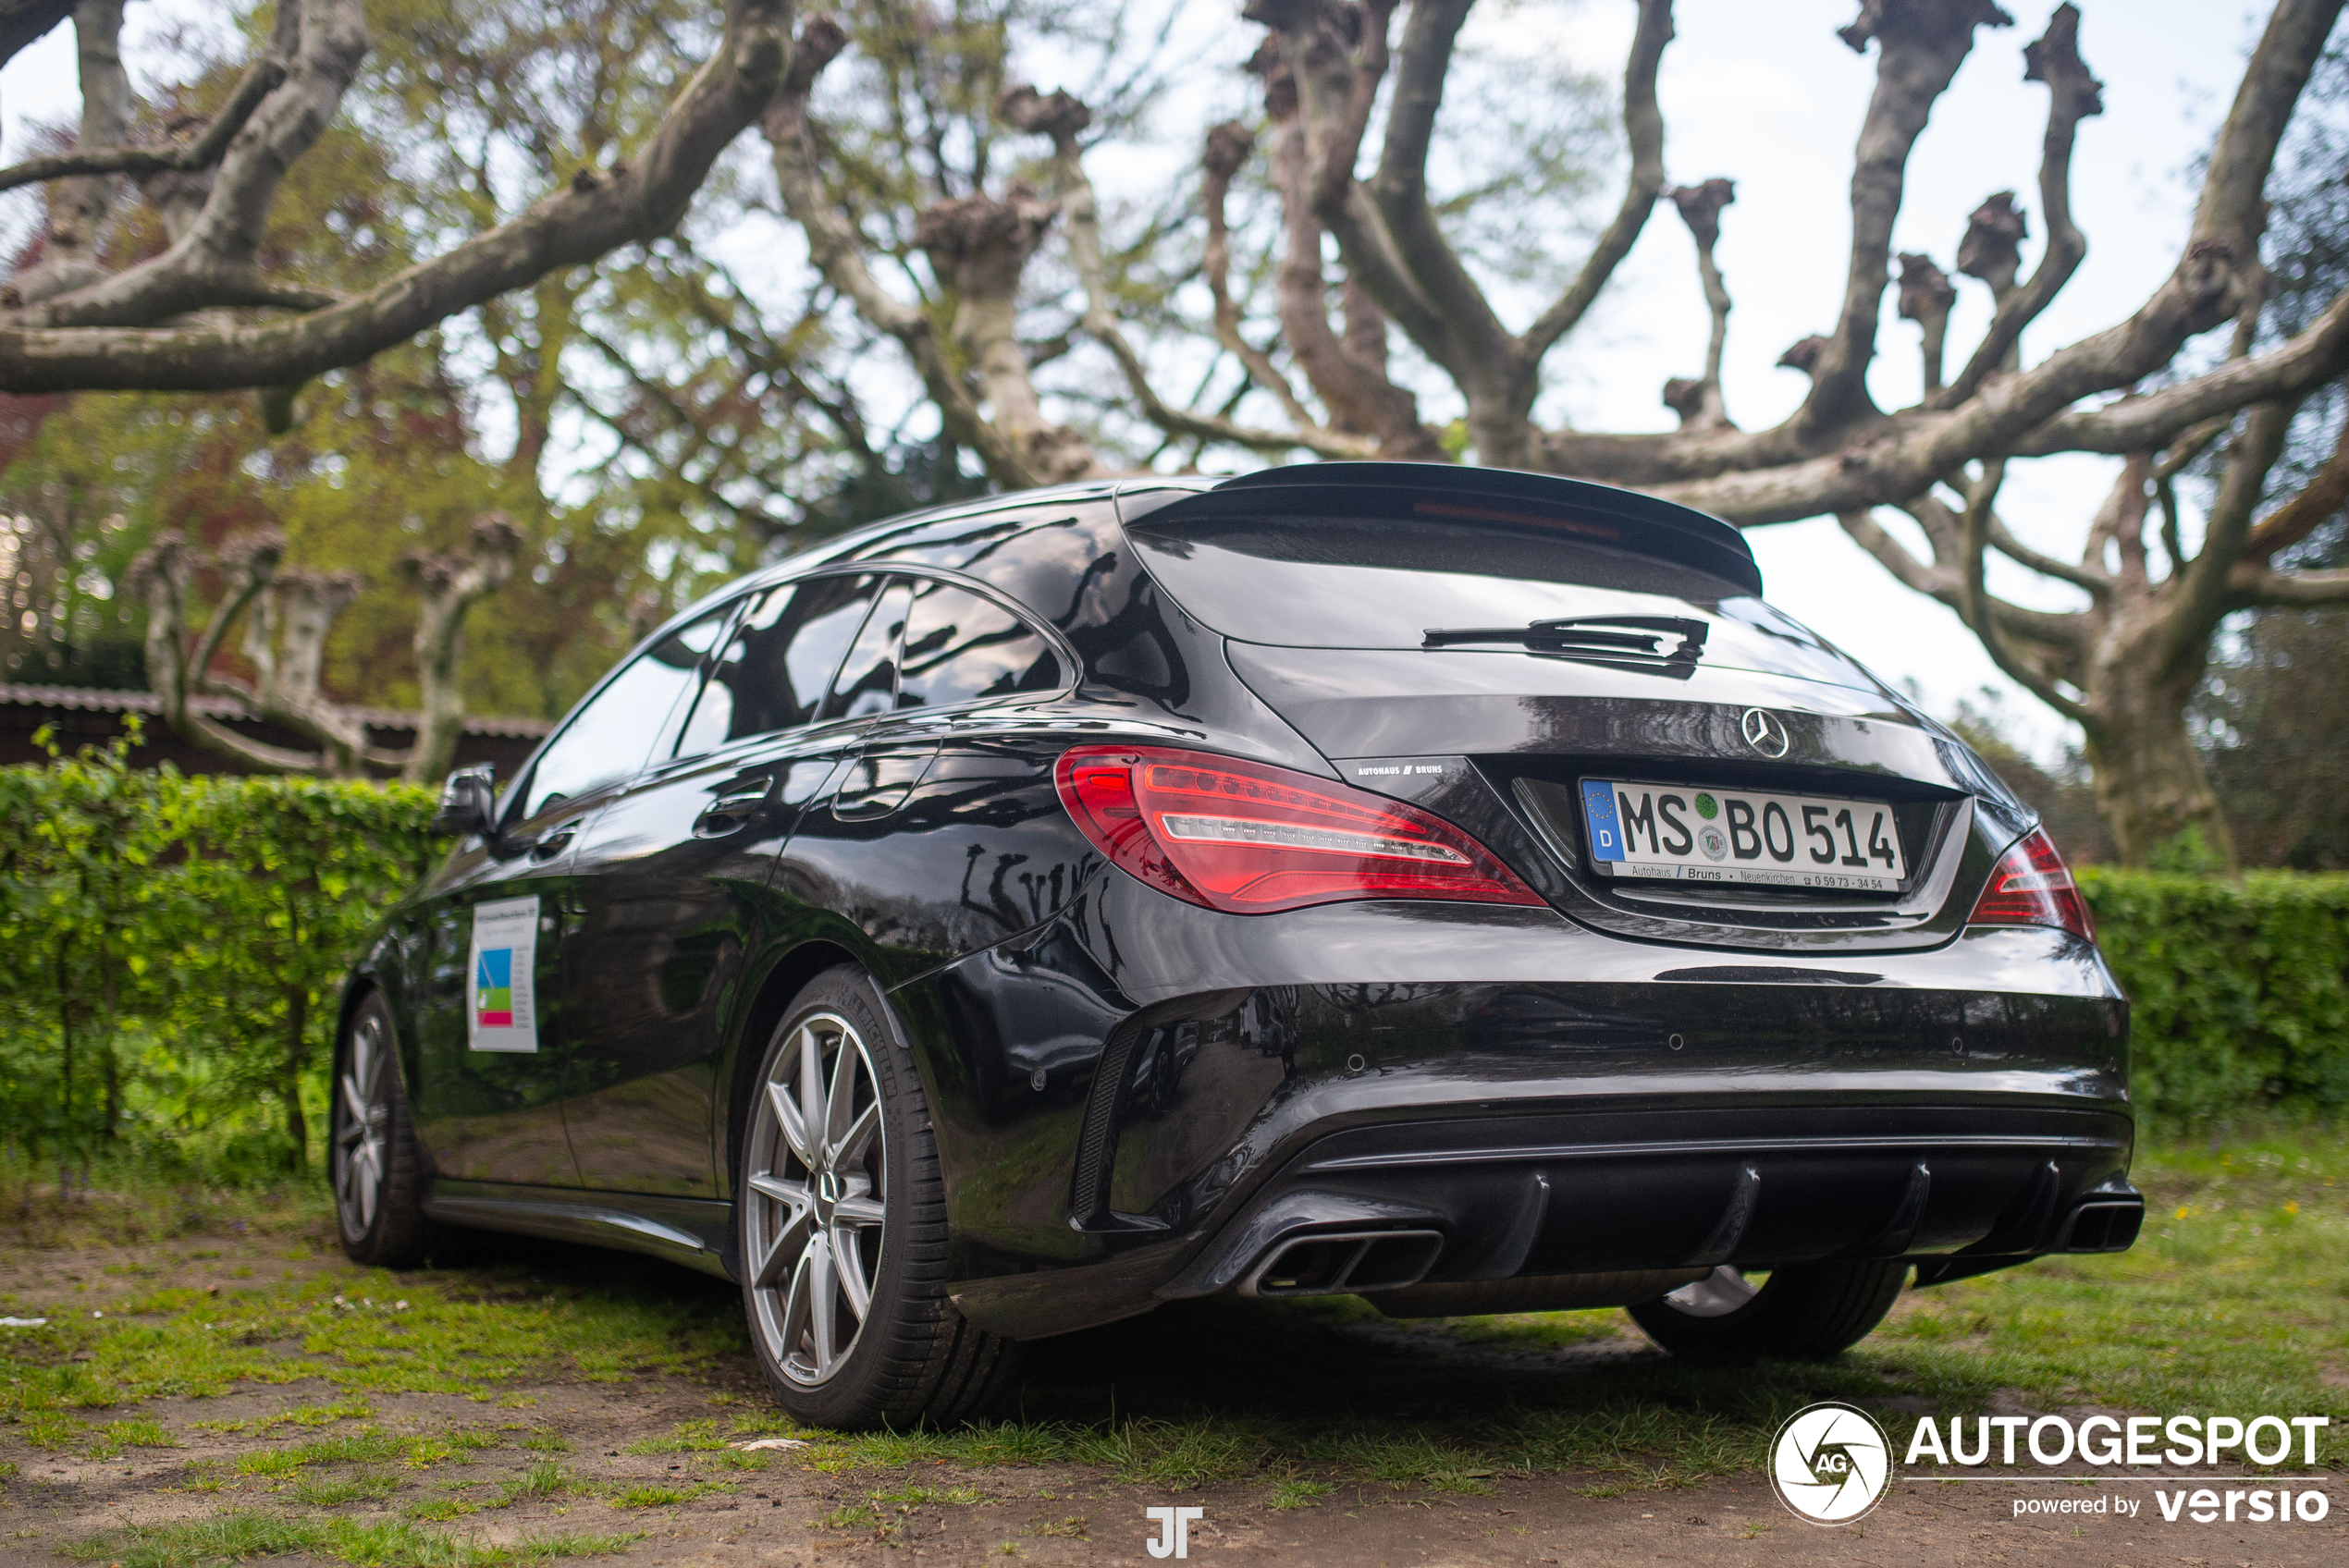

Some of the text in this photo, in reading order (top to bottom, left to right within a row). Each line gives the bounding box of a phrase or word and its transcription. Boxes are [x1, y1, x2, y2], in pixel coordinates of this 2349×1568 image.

[1358, 766, 1443, 776] AUTOHAUS BRUNS
[1600, 829, 1612, 848] D
[1617, 791, 1895, 869] MS BO 514
[1632, 865, 1671, 878] Autohaus
[1688, 868, 1721, 880] Bruns
[1740, 871, 1795, 885] Neuenkirchen
[859, 1010, 897, 1097] MICHELIN
